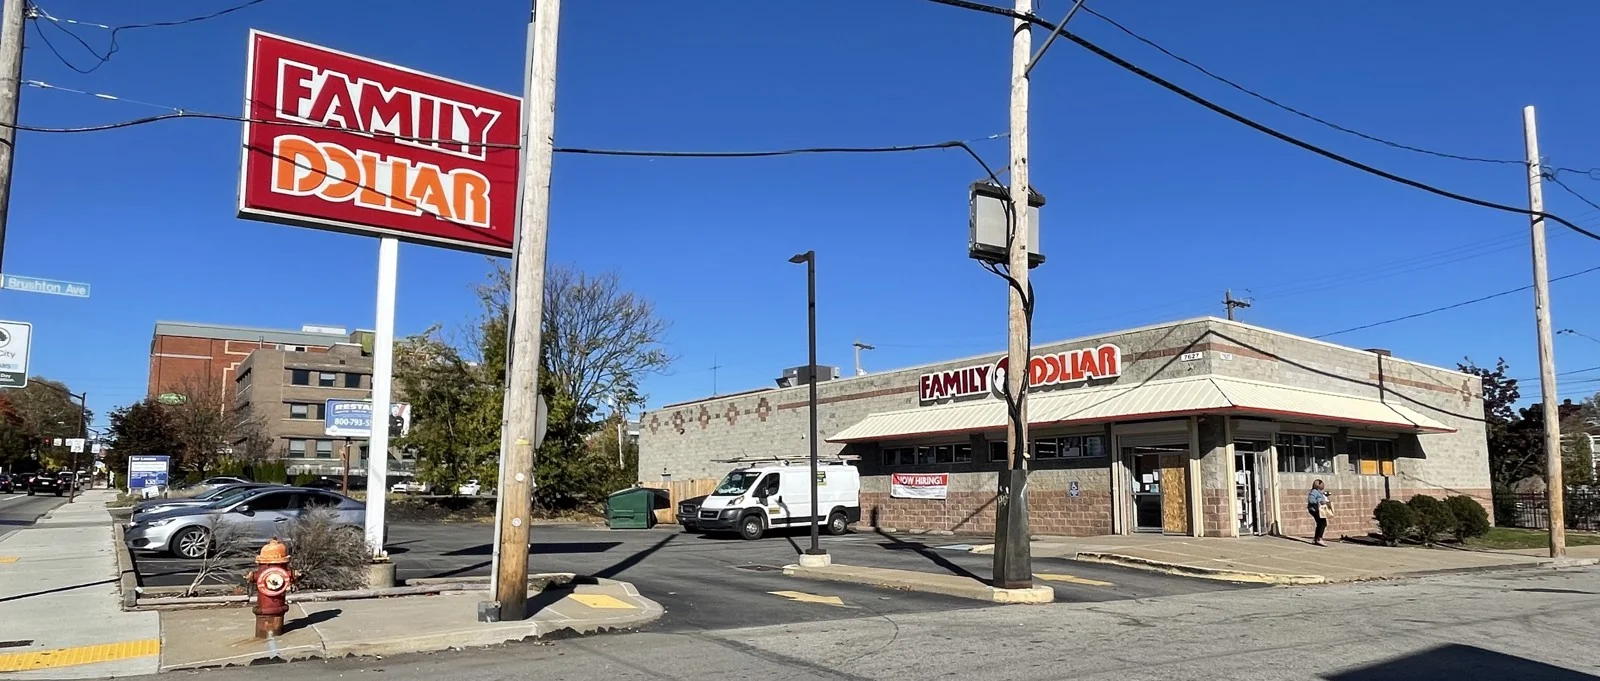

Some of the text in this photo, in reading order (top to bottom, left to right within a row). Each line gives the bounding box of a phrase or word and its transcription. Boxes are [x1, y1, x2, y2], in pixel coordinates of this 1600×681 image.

[276, 57, 502, 162] FAMILY
[271, 134, 491, 229] DOLLAR
[8, 277, 87, 295] Brushton Ave
[919, 343, 1122, 401] FAMILY DOLLAR
[915, 475, 943, 485] HIRING!
